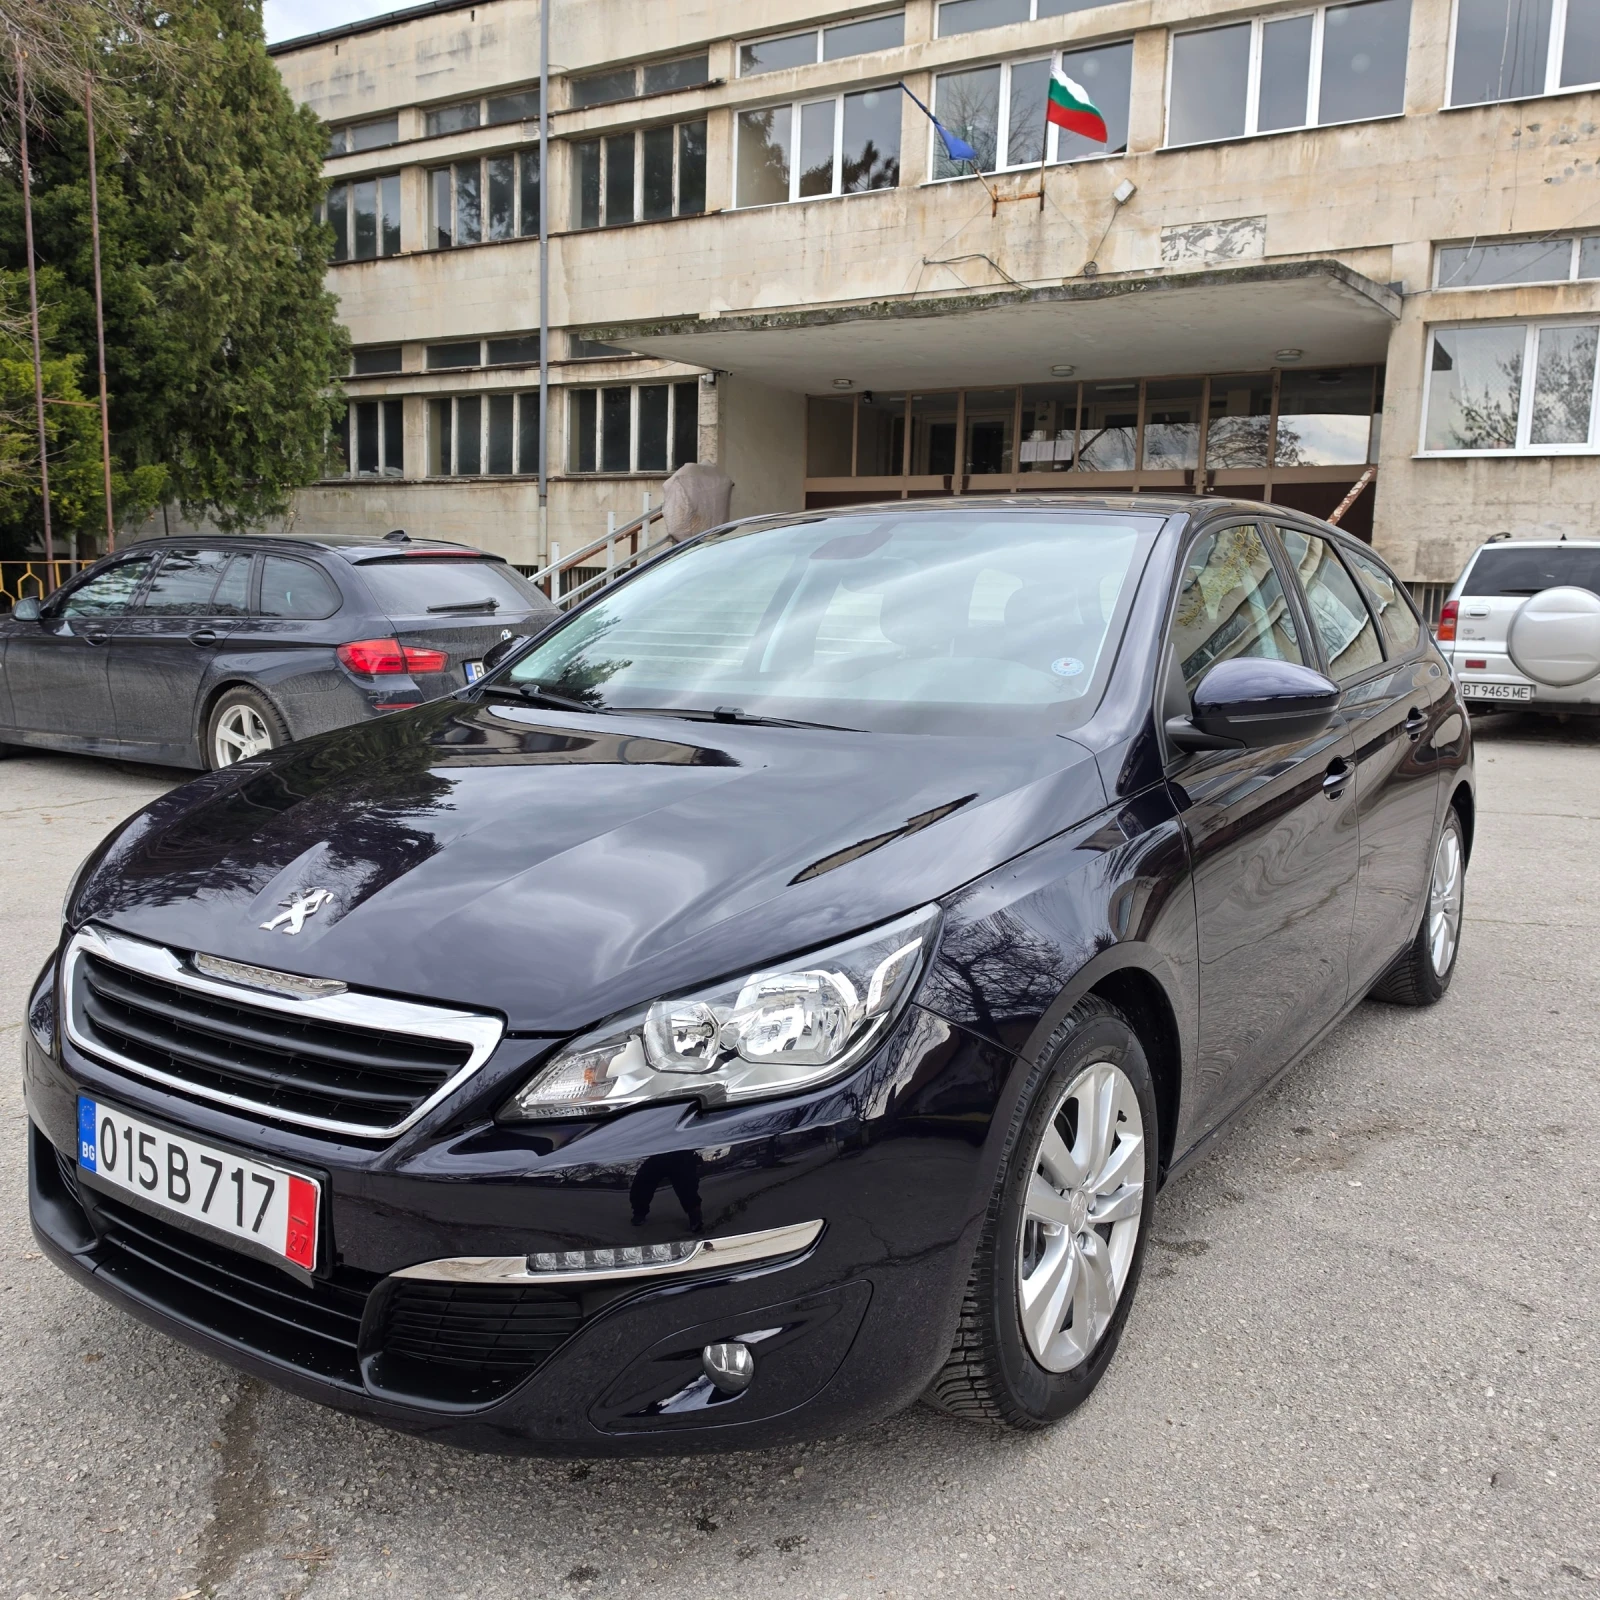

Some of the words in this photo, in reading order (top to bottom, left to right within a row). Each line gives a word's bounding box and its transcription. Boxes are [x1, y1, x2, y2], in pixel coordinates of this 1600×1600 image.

[1463, 684, 1480, 695] BT
[1481, 686, 1510, 697] 9465
[1512, 687, 1529, 698] ME
[206, 958, 296, 987] PEUGEOT
[81, 1140, 96, 1162] BG
[288, 1231, 308, 1254] 27
